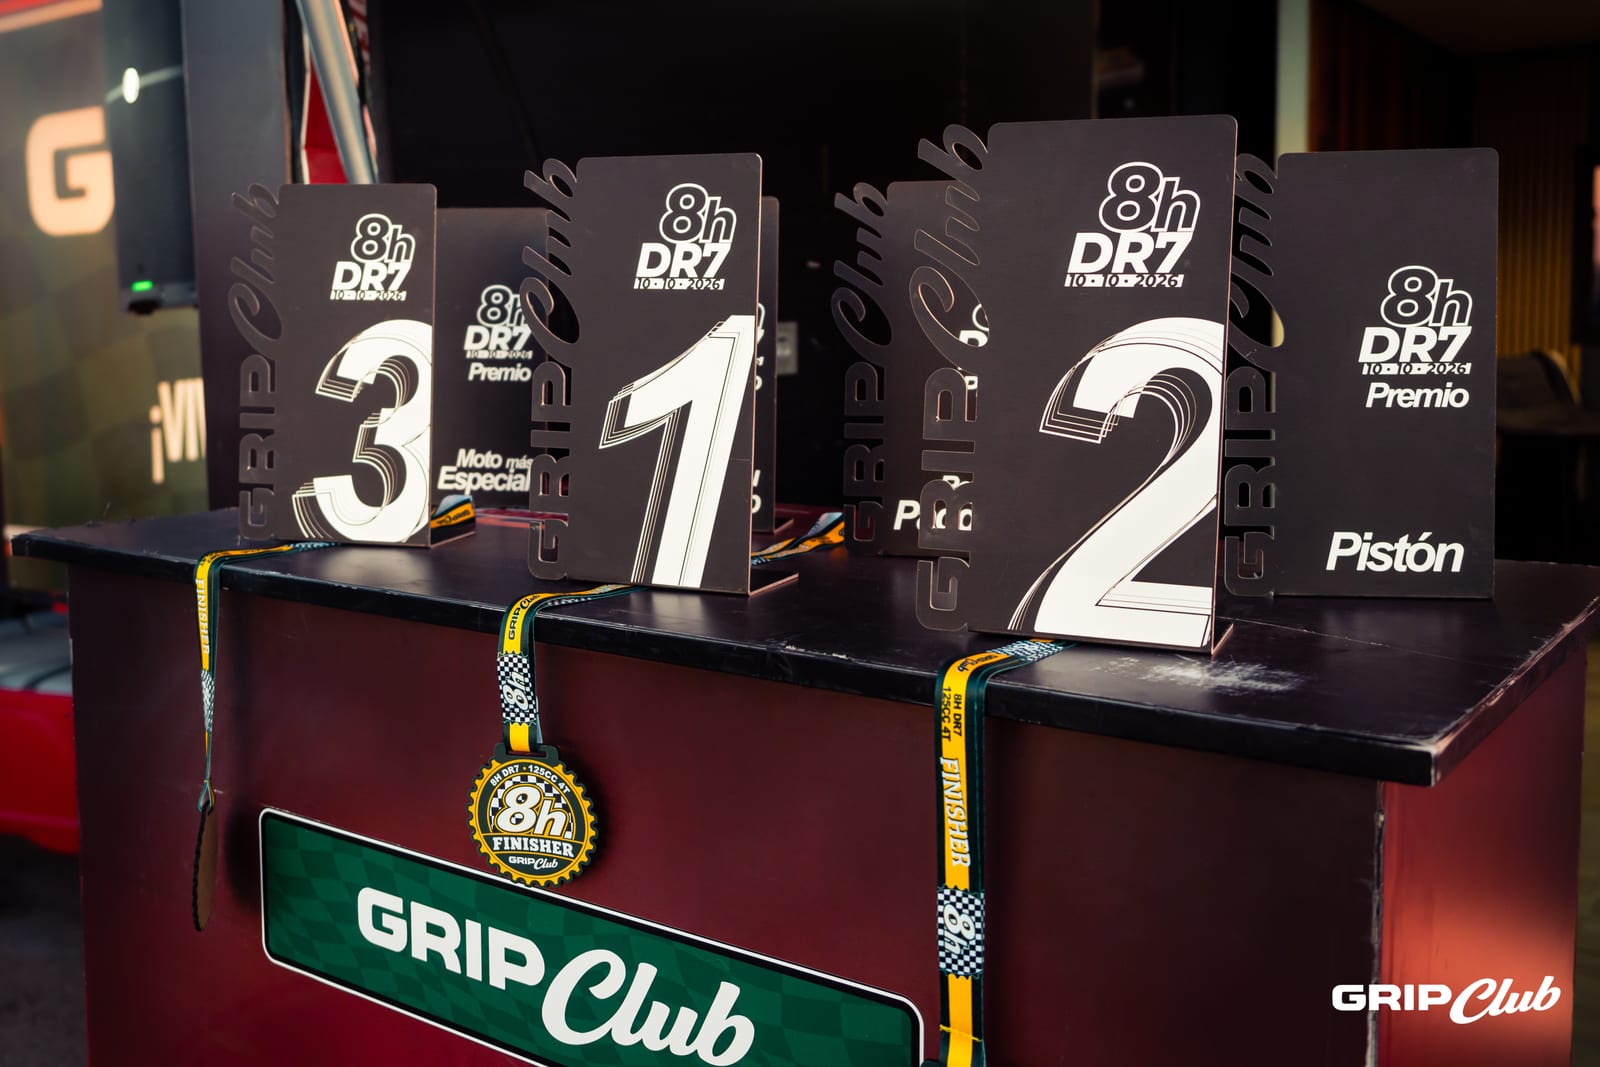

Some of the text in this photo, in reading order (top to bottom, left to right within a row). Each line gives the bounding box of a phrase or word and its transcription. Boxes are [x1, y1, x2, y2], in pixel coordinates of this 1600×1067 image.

[659, 183, 737, 243] 8h
[1099, 161, 1201, 233] 8h
[351, 213, 416, 263] 8h
[636, 241, 732, 278] DR7
[1067, 231, 1194, 274] DR7
[331, 260, 412, 291] DR7
[1380, 265, 1473, 328] 8h
[463, 324, 532, 351] DR7
[1358, 326, 1472, 362] DR7
[468, 361, 532, 382] Premio
[1365, 381, 1470, 408] Premio
[238, 353, 277, 540] GRIP
[292, 318, 434, 541] 3
[598, 314, 756, 589] 1
[437, 465, 532, 496] Especial
[456, 448, 503, 469] Moto
[528, 360, 571, 580] GRIP
[1007, 316, 1225, 647] 2
[916, 367, 978, 631] GRIP
[1325, 531, 1465, 572] Pistón
[502, 671, 530, 711] 8h
[941, 686, 952, 742] 125CC 4T
[953, 693, 962, 736] 8H DR7
[490, 764, 571, 794] 8H DR7 125CC 4T
[496, 785, 568, 837] 8h
[940, 756, 971, 868] FINISHER
[492, 836, 574, 858] FINISHER
[508, 856, 559, 870] GRIP Club
[943, 902, 977, 955] 8h
[357, 886, 755, 1067] GRIP Club
